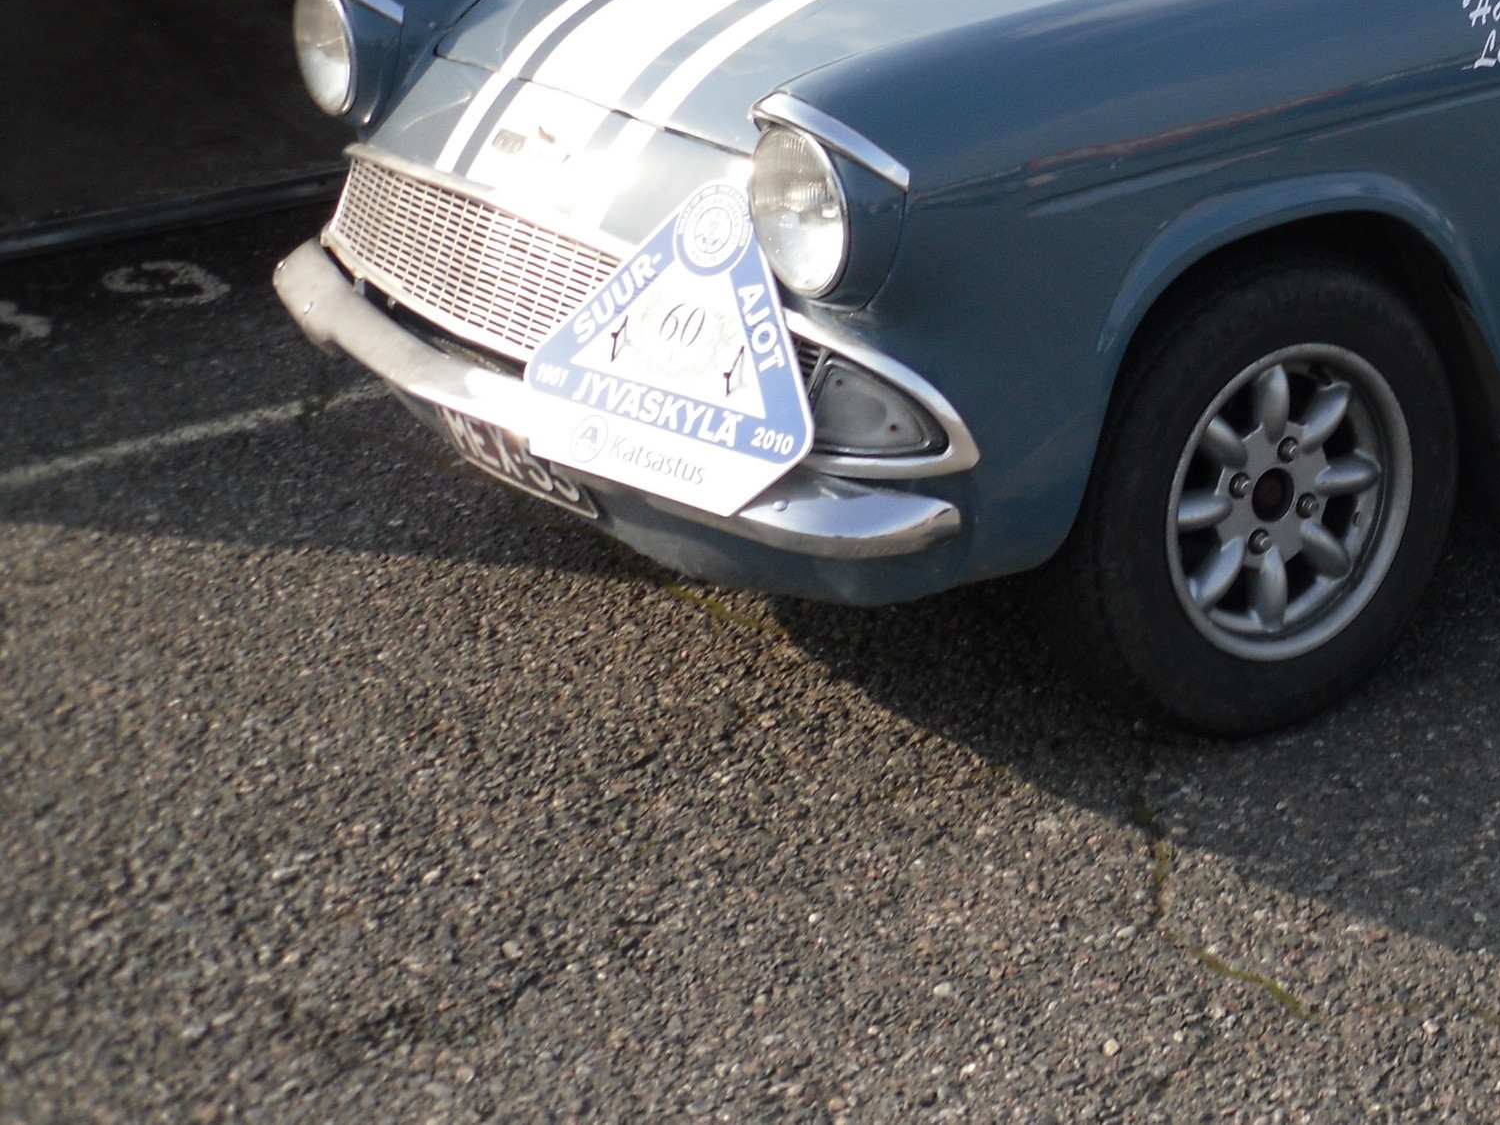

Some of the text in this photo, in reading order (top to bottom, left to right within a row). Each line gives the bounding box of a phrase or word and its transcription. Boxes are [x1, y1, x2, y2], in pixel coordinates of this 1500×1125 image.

[573, 253, 662, 344] SUUR-
[659, 302, 706, 347] 60
[738, 283, 785, 373] AJOT
[572, 371, 743, 448] JYVÄSKYLÄ
[751, 426, 795, 456] 2010
[611, 436, 706, 485] Katsastus
